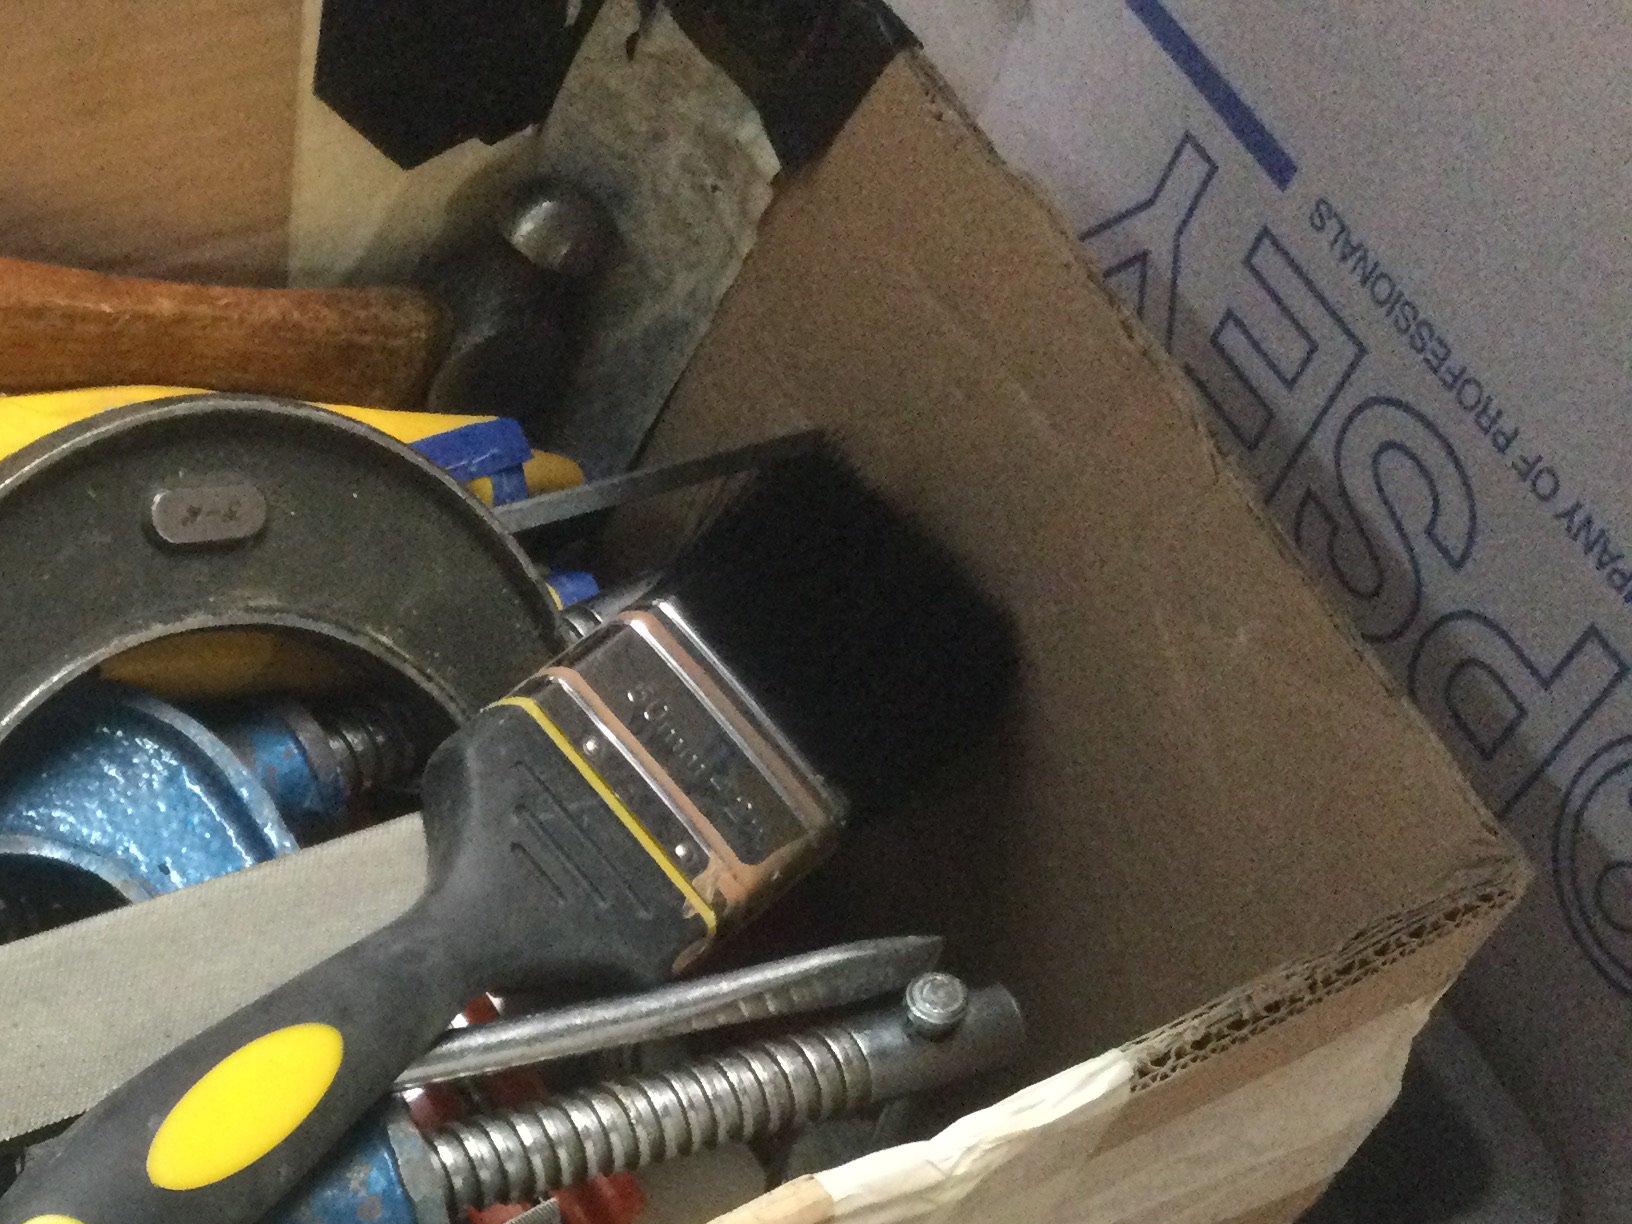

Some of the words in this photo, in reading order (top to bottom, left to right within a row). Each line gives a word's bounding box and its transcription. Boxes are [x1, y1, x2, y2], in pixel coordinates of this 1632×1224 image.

[1307, 197, 1520, 455] PROFESSIONALS
[1511, 454, 1561, 502] OF
[1553, 500, 1632, 605] PANY
